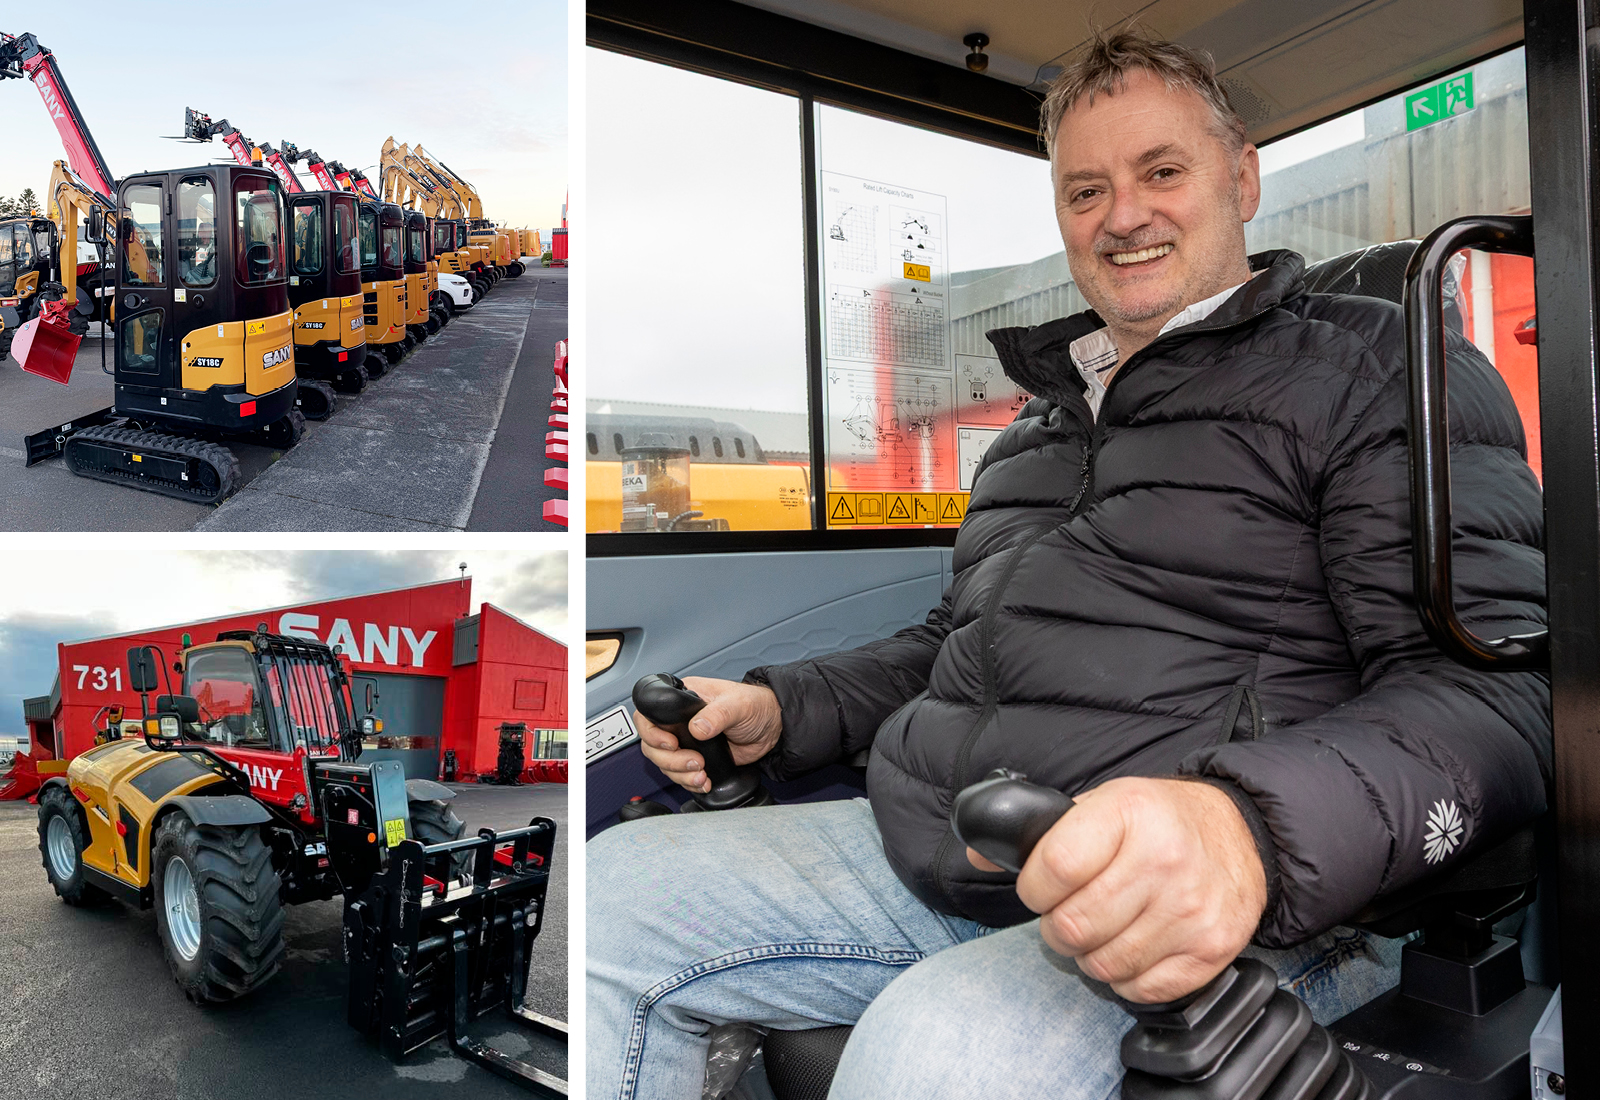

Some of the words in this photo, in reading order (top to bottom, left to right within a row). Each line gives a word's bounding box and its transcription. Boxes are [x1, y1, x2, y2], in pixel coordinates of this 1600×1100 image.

[35, 71, 65, 120] SANY
[231, 143, 251, 166] SAN
[883, 187, 900, 197] Capacity
[901, 190, 914, 199] Charts
[197, 357, 220, 367] SY18C
[263, 344, 291, 369] SANY
[278, 612, 438, 668] SANY
[72, 664, 123, 693] 731
[229, 761, 284, 792] ANY
